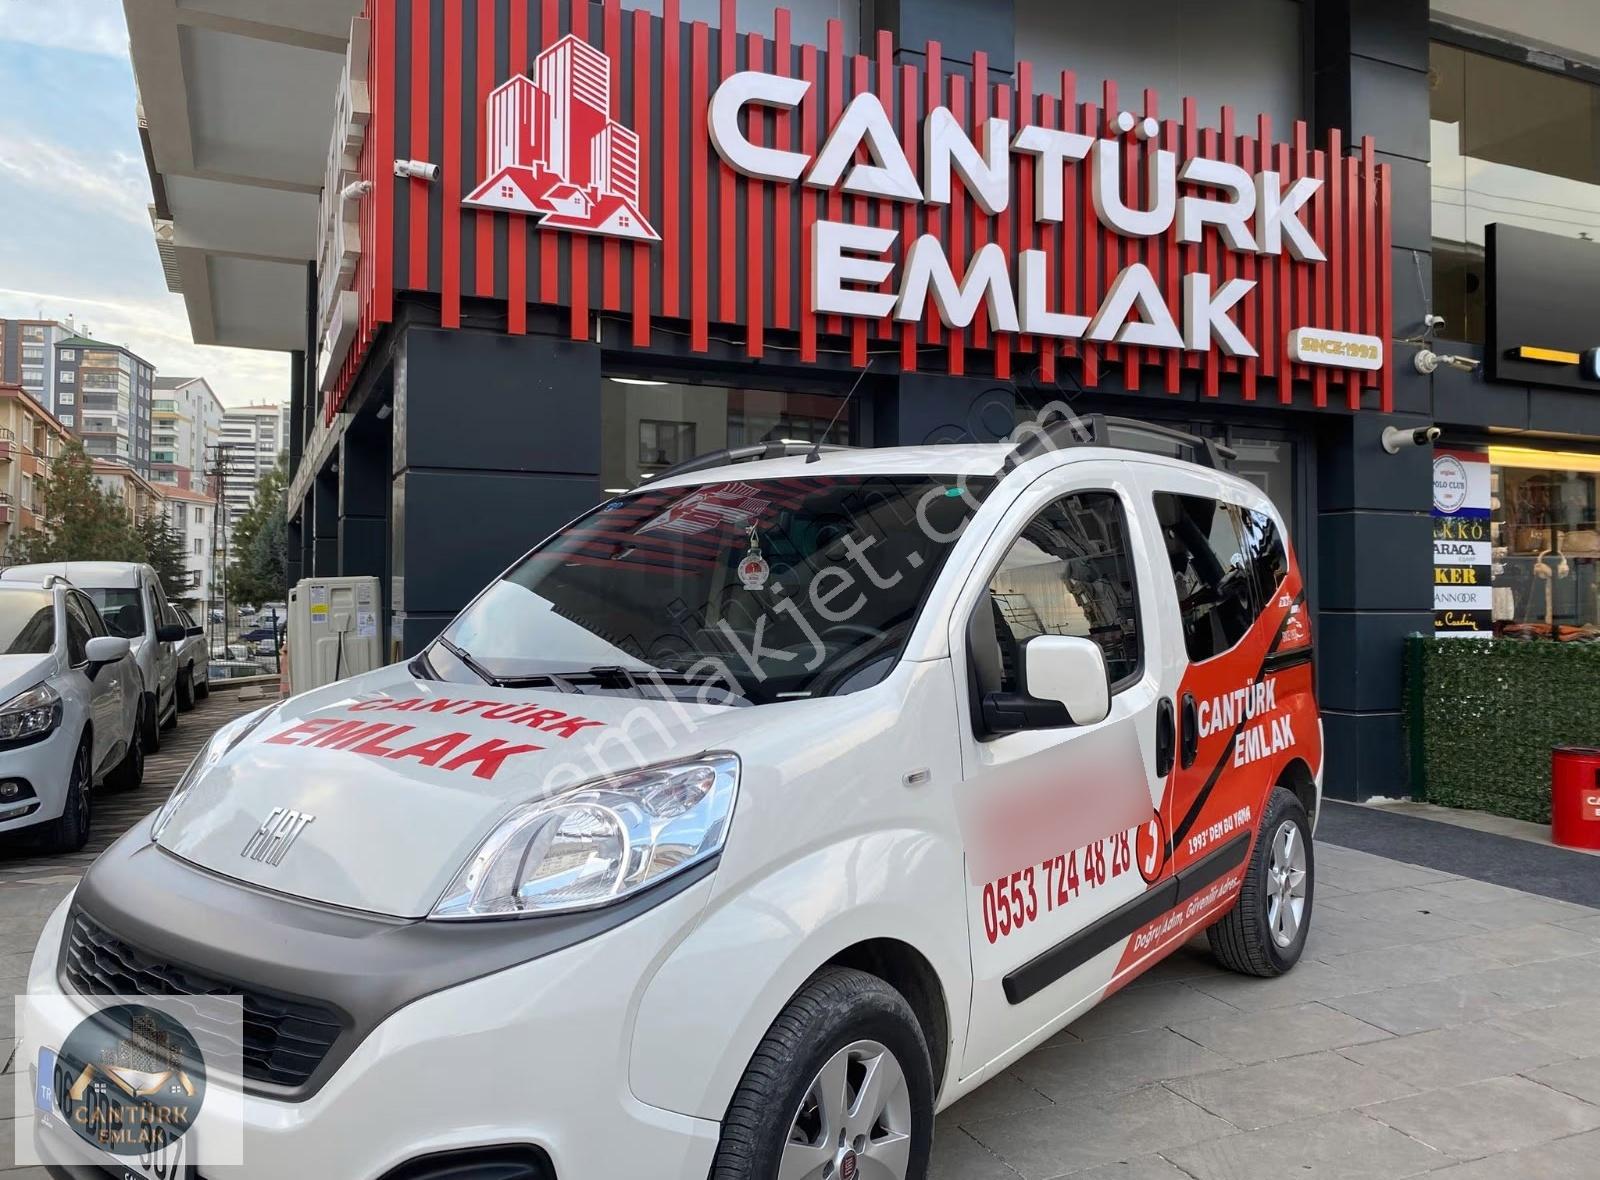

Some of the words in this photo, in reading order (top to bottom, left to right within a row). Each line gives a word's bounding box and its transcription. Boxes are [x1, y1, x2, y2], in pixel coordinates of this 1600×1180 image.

[708, 71, 1327, 263] CANTÜRK
[811, 219, 1259, 357] EMLAK
[347, 697, 608, 739] CANTÜRK
[1198, 677, 1278, 738] CANTÜRK
[264, 718, 546, 781] EMLAK
[1234, 713, 1296, 769] EMLAK
[240, 807, 316, 867] FIAT
[983, 866, 1038, 945] 0553
[1043, 850, 1080, 913] 724
[1084, 839, 1107, 889] 48
[1109, 829, 1131, 879] 28
